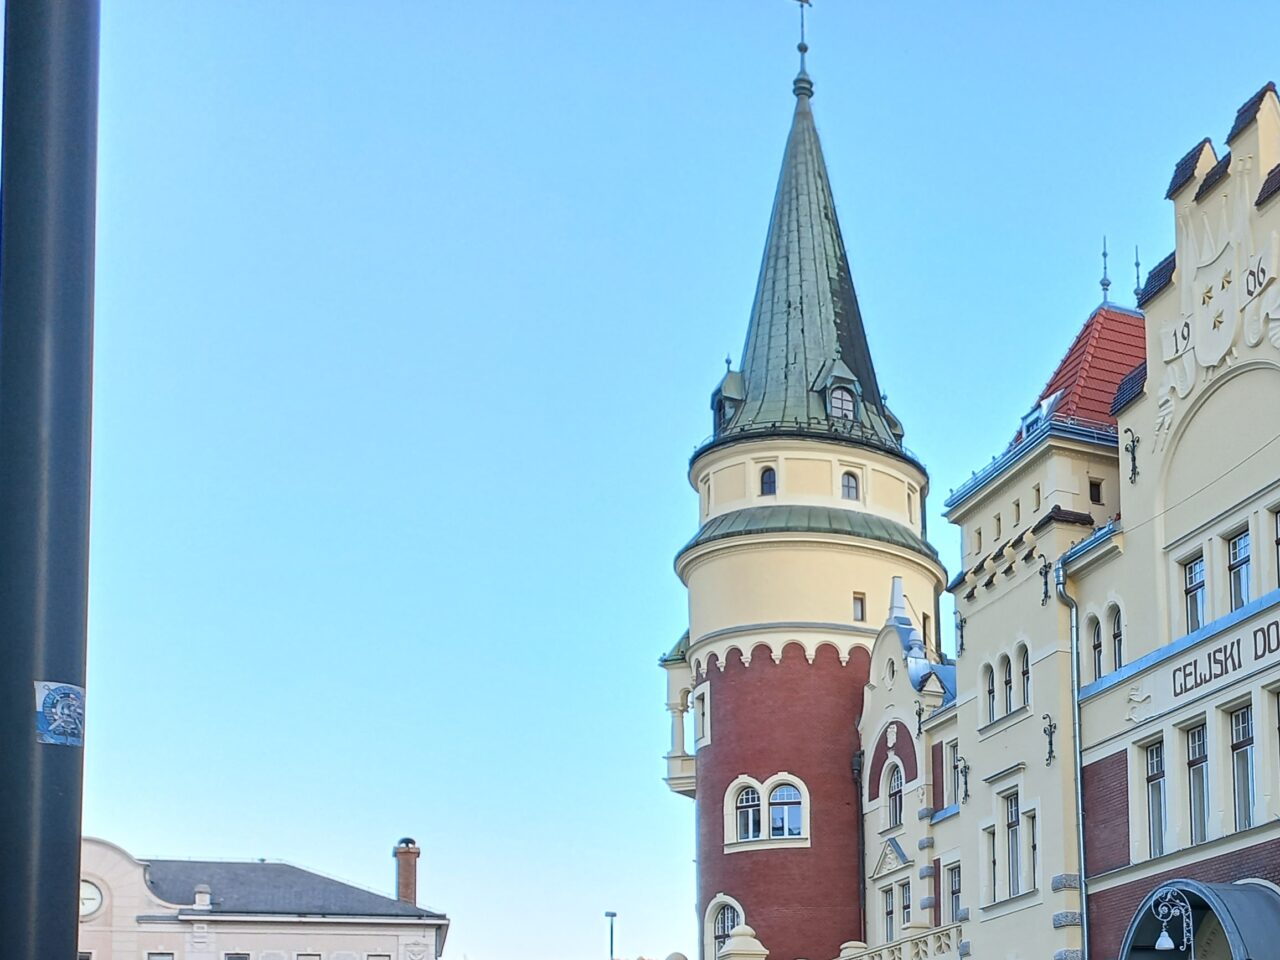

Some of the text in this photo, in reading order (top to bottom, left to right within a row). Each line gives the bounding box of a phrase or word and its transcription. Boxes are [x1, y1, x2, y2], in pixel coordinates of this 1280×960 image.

[1172, 256, 1267, 355] 19 06
[1172, 638, 1243, 698] CELJSKI
